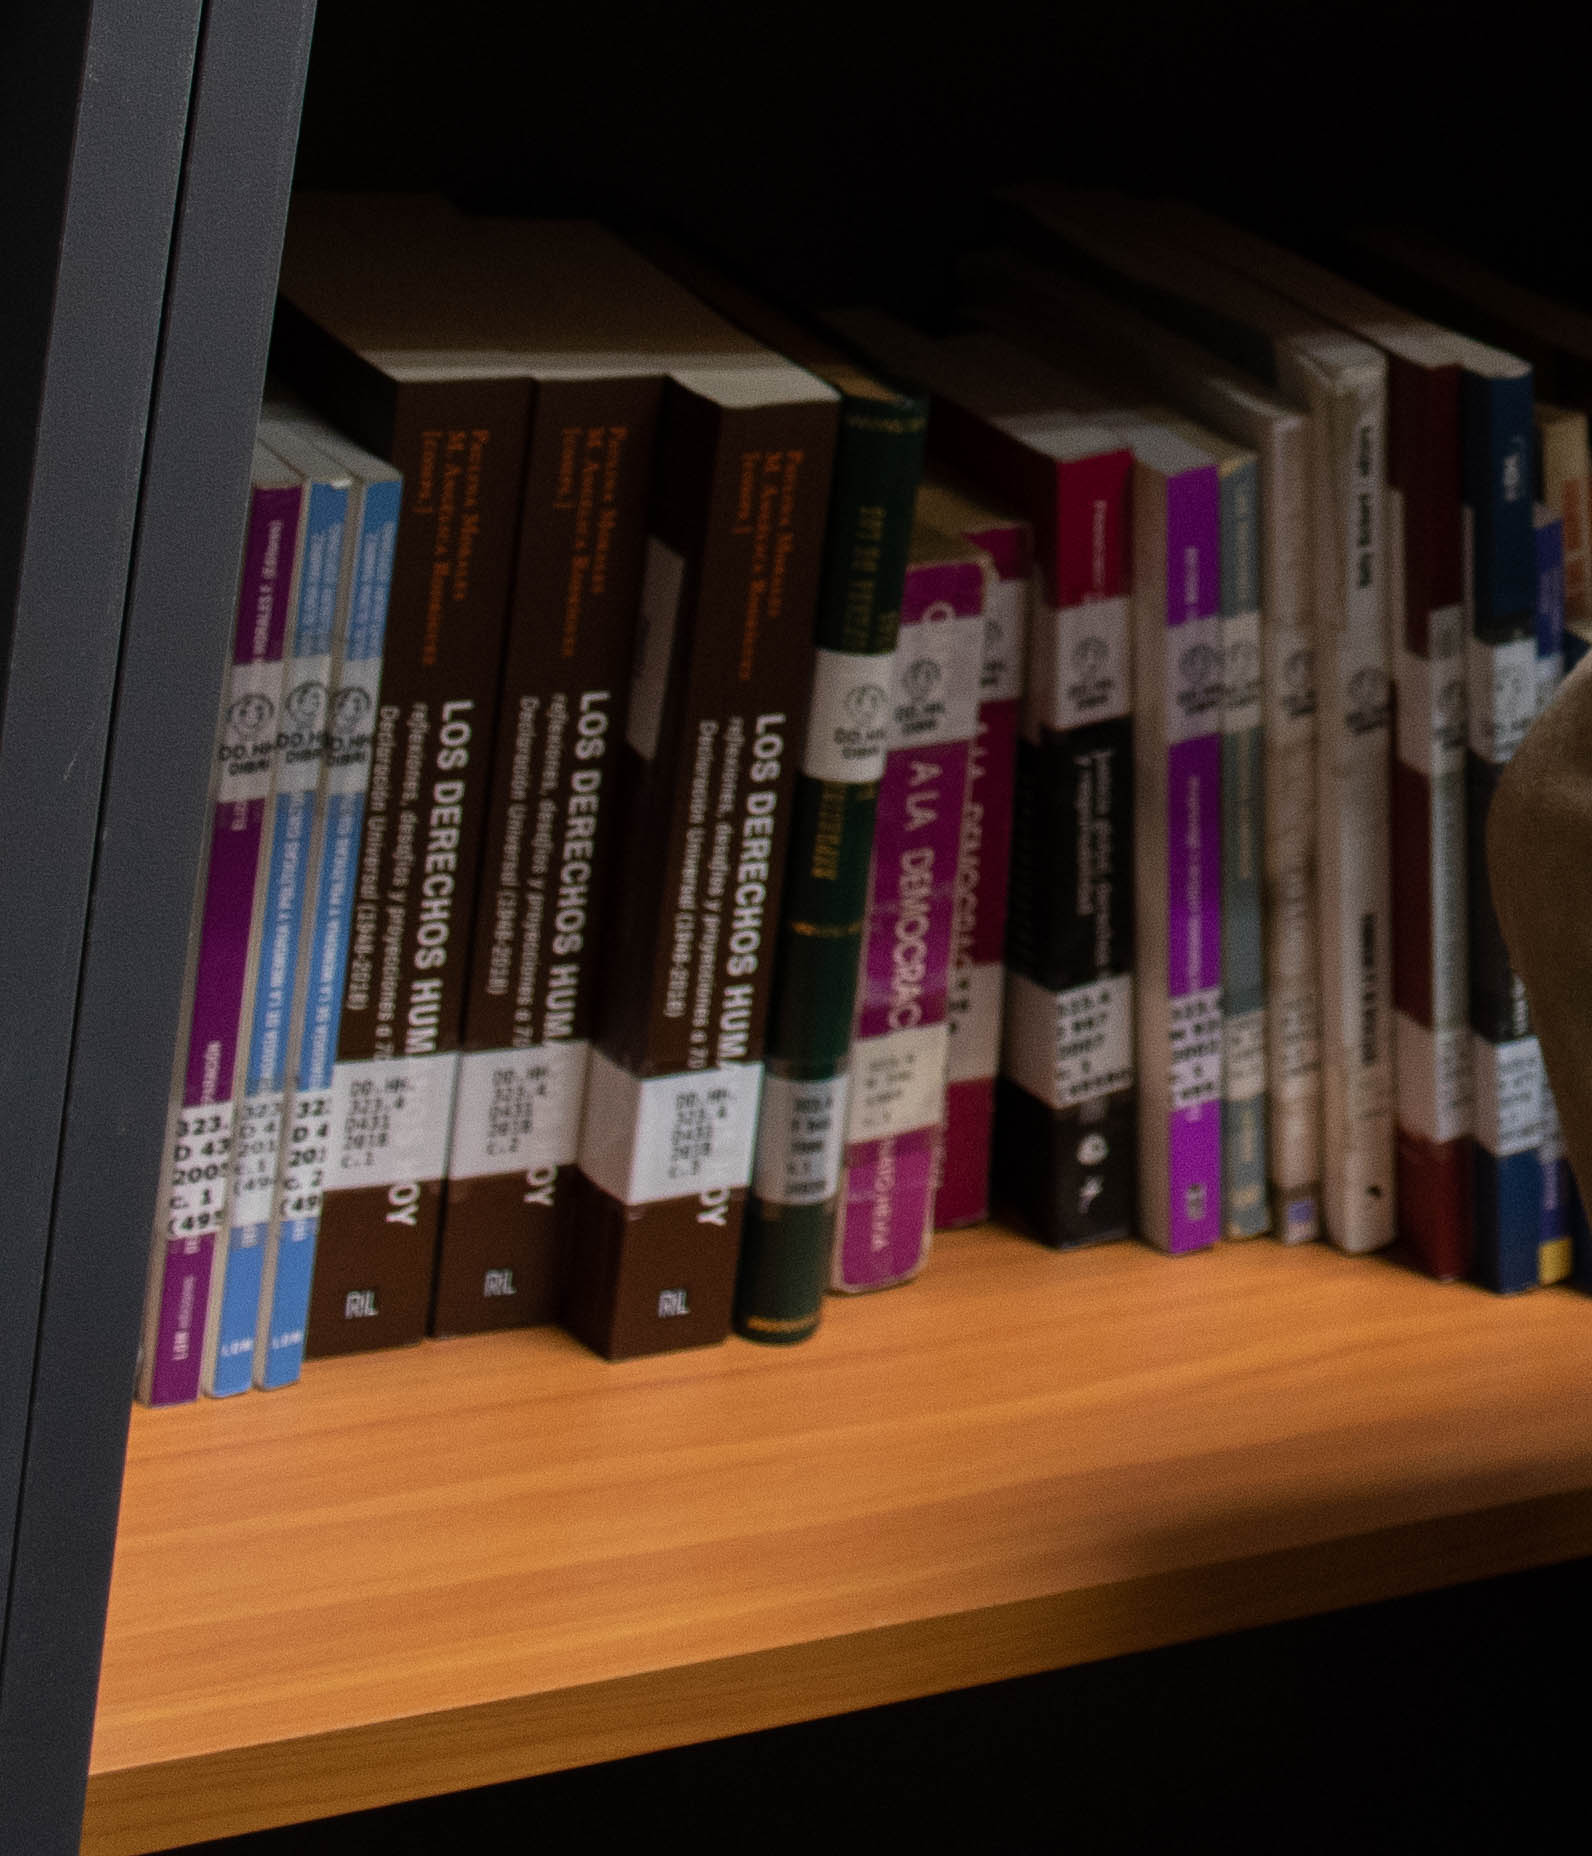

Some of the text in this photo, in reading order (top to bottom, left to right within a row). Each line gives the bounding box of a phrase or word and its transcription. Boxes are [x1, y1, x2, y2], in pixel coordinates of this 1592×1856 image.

[437, 699, 475, 771] LOS
[575, 690, 611, 761] LOS
[750, 713, 787, 782] LOS
[905, 796, 939, 831] LA
[413, 780, 466, 970] DERECHOS
[552, 769, 601, 955] DERECHOS
[727, 791, 777, 977] DERECHOS
[385, 1182, 421, 1226] OY
[523, 1165, 558, 1207] OY
[696, 1189, 731, 1227] OY
[346, 1291, 378, 1319] RIL
[484, 1269, 515, 1297] RIL
[659, 1290, 690, 1317] RIL
